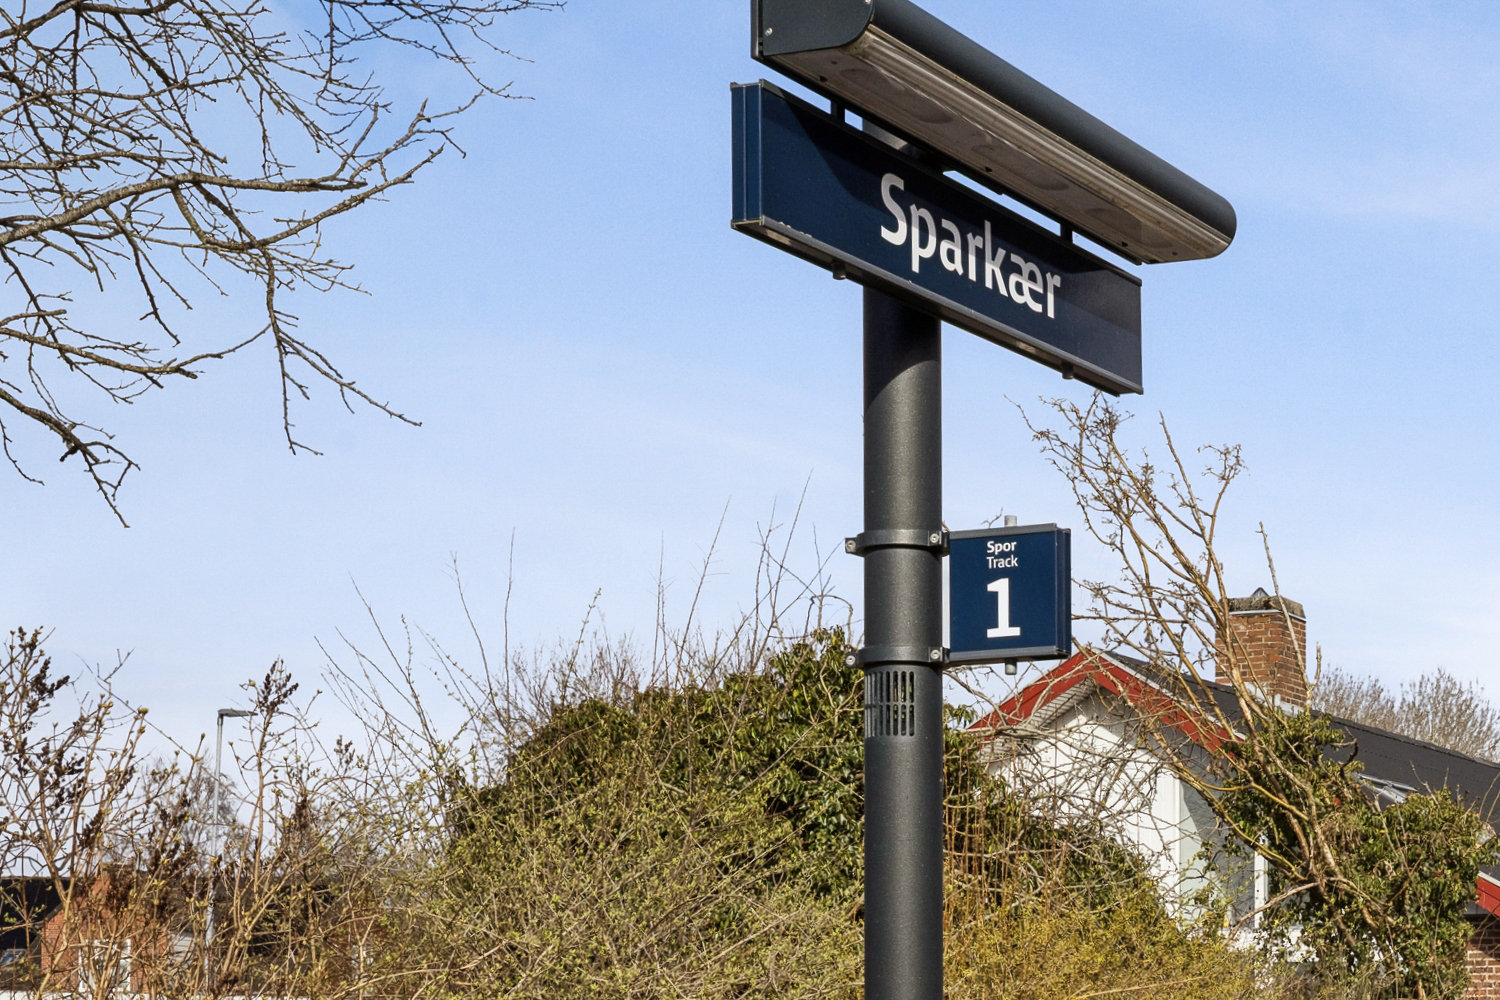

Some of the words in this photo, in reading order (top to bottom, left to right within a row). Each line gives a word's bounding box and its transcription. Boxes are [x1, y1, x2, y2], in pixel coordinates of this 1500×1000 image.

[880, 172, 1062, 319] Sparkær
[986, 540, 1017, 555] Spor
[986, 554, 1019, 569] Track
[986, 577, 1021, 639] 1
